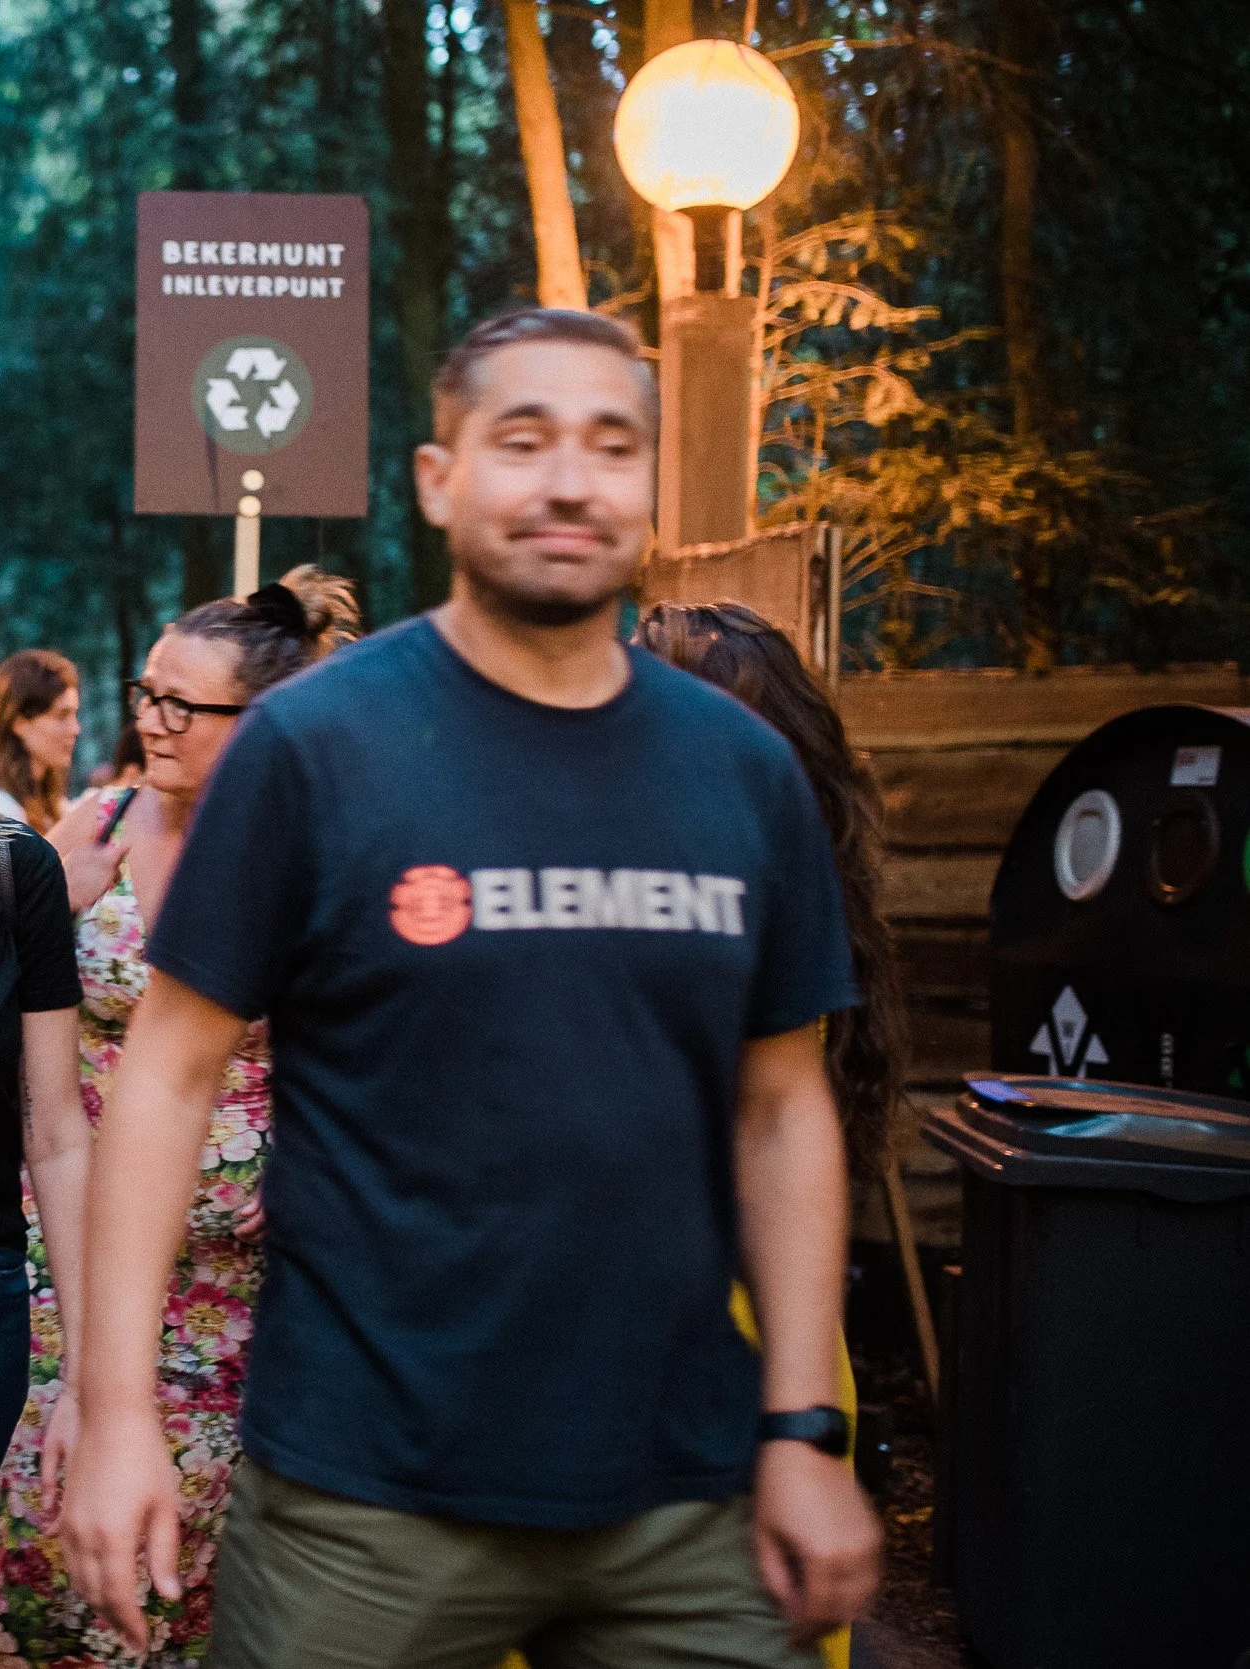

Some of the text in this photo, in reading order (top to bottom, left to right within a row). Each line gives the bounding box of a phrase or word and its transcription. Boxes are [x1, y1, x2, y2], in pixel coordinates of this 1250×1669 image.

[161, 240, 344, 267] BEKERMUNT
[161, 274, 344, 298] INLEVERPUNT
[471, 867, 747, 935] ELEMENT
